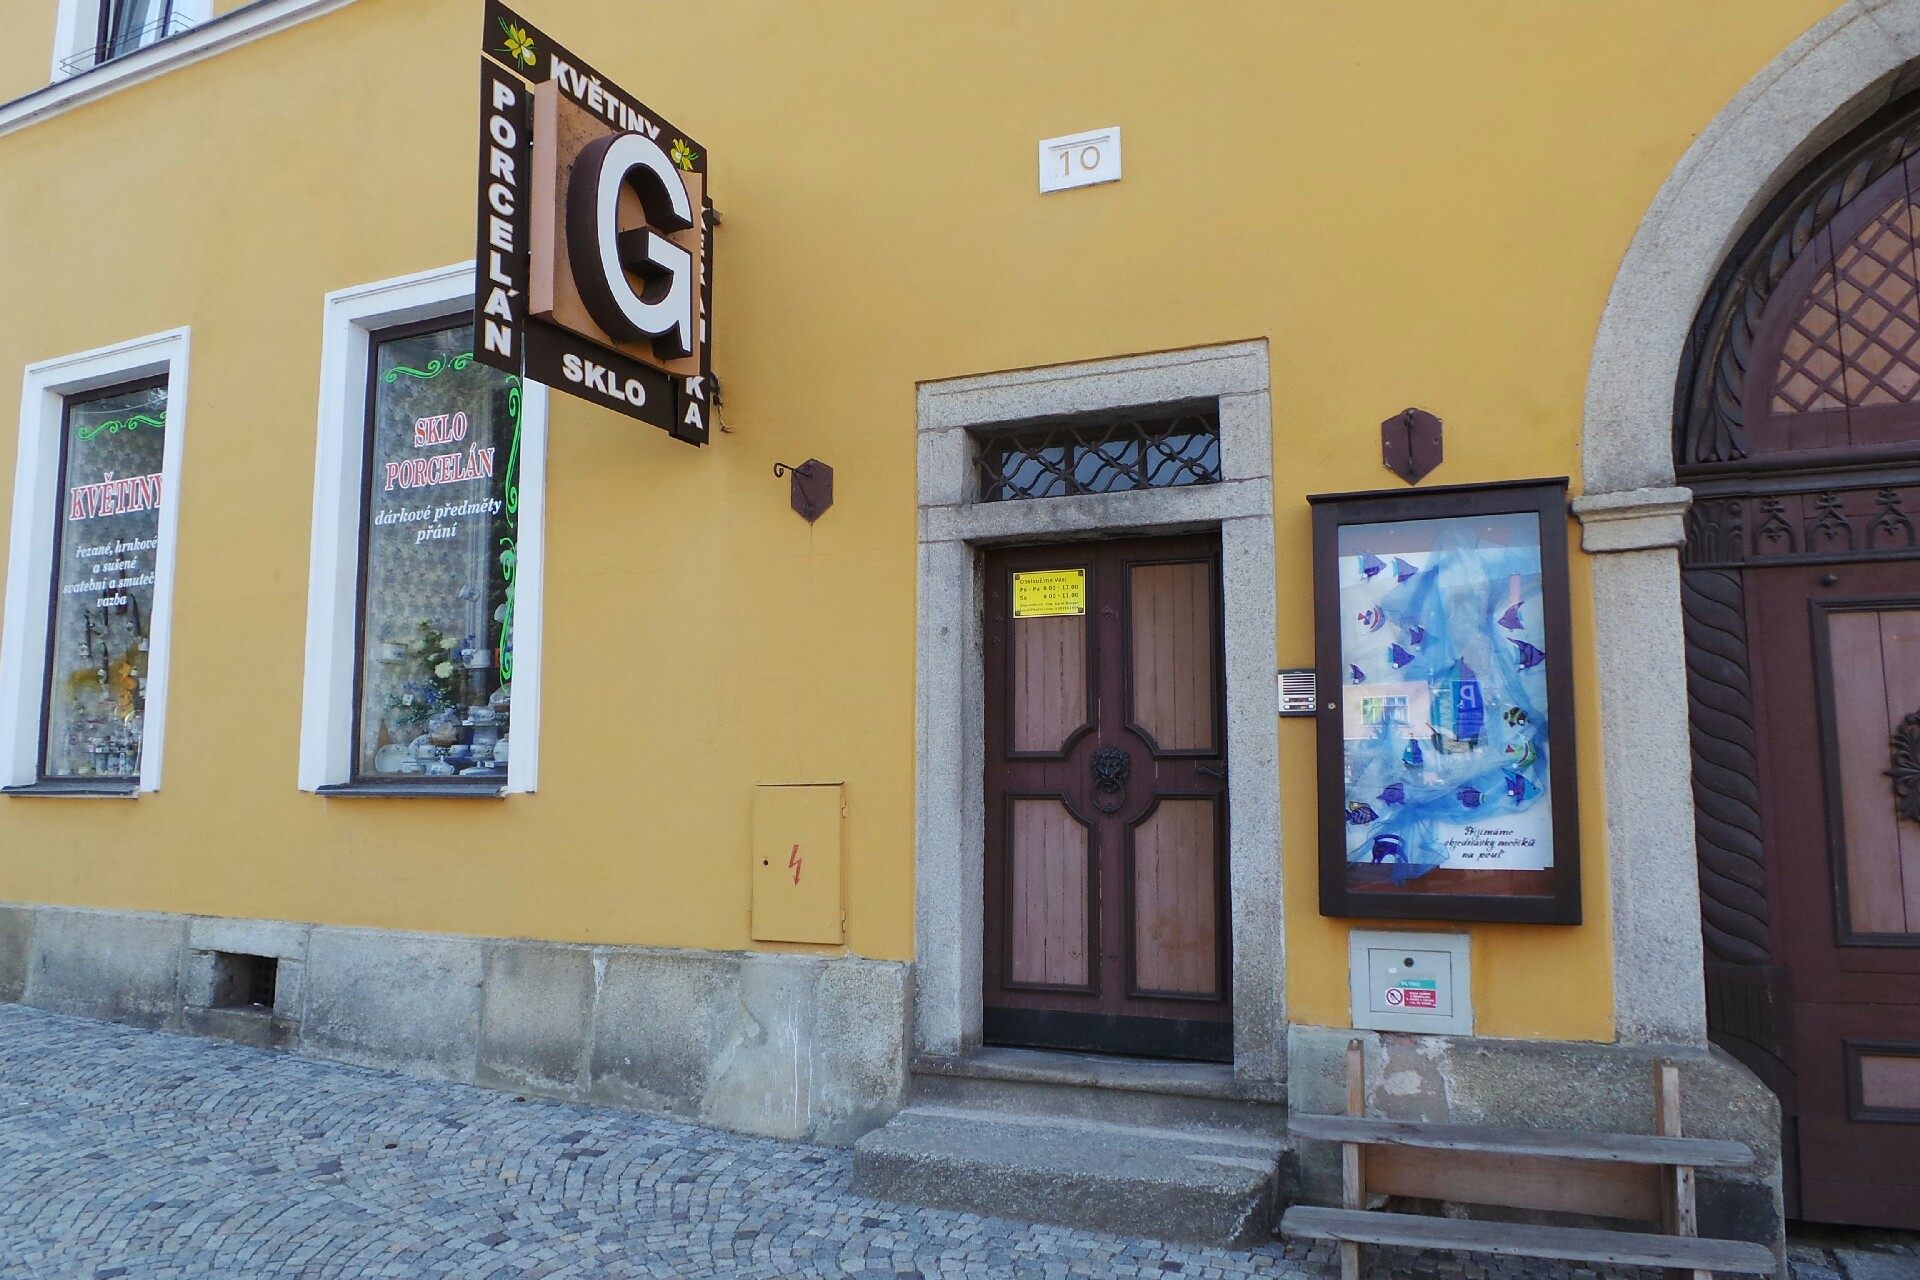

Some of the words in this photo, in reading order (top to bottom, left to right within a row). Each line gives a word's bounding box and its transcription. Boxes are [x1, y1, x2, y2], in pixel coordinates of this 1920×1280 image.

[549, 53, 661, 142] KVĚTINY
[1060, 146, 1101, 176] 10
[484, 80, 517, 358] PORCELÁN
[590, 132, 693, 355] G
[562, 353, 647, 408] SKLO
[415, 411, 468, 448] SKLO
[384, 442, 496, 491] PORCELÁN
[374, 504, 431, 525] dárkové
[433, 498, 502, 522] předměty
[115, 535, 158, 555] hrnkové
[415, 522, 458, 545] přání
[92, 564, 100, 574] a
[102, 556, 138, 573] sušené
[62, 577, 107, 594] svatební
[108, 579, 117, 589] a
[97, 593, 127, 608] vazba
